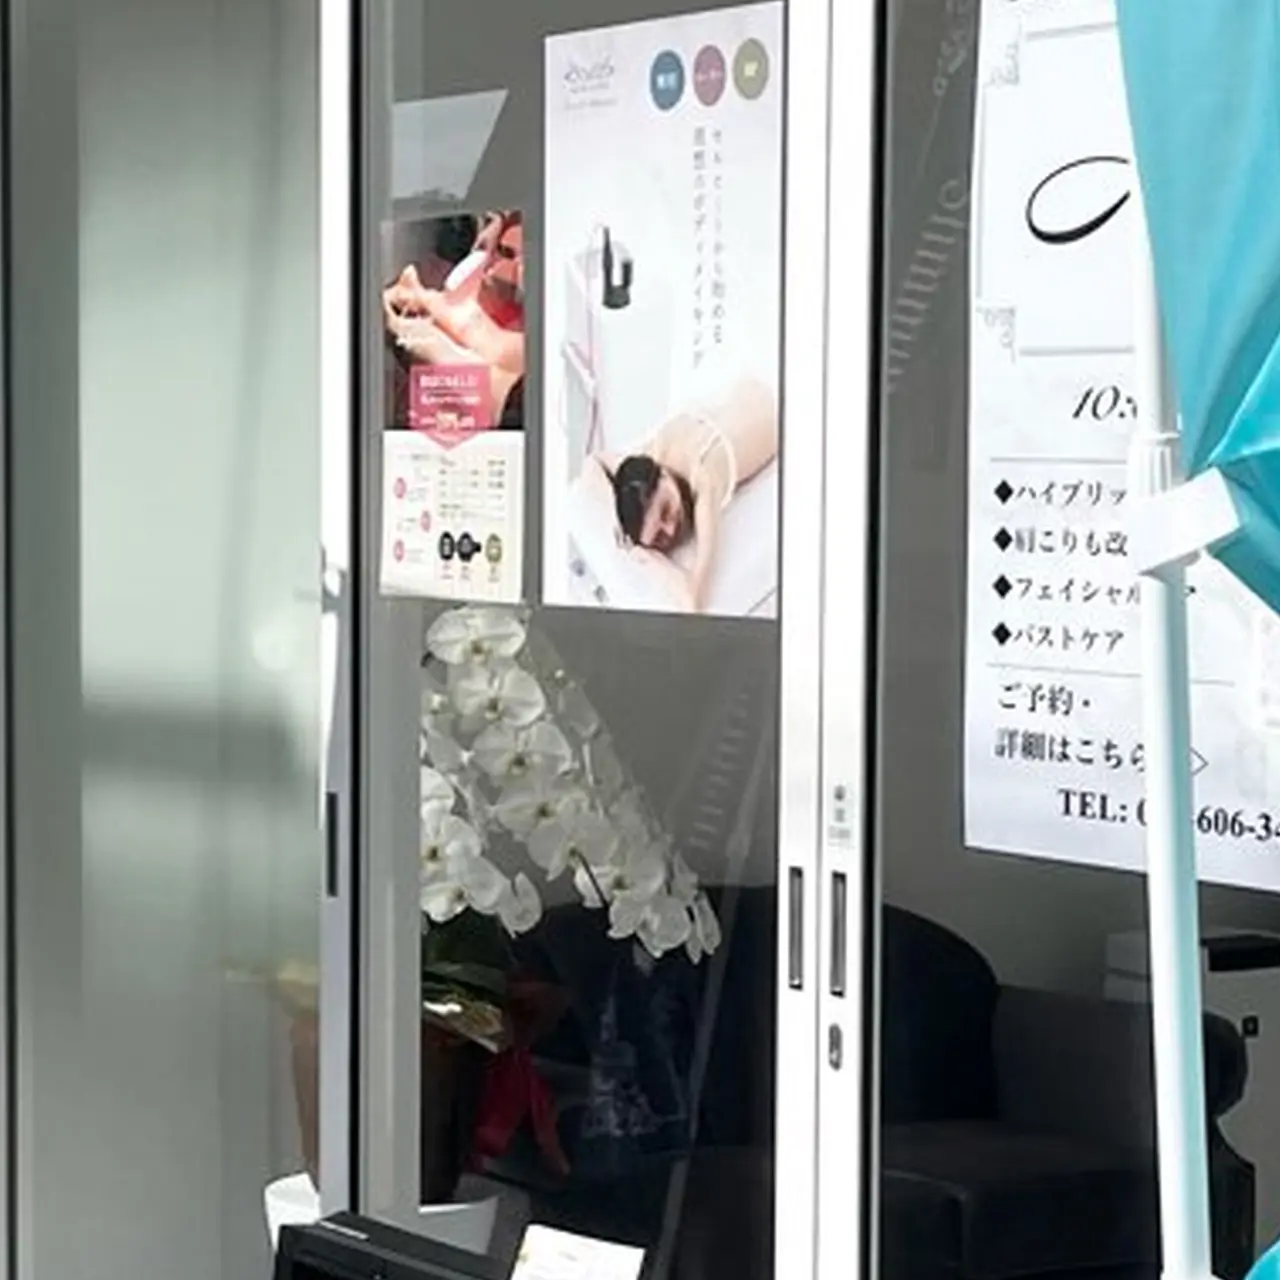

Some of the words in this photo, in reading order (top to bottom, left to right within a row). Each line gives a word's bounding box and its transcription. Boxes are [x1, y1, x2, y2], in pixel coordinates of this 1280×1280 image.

[1014, 622, 1124, 654] バストケア
[997, 681, 1091, 717] ご予約・
[1057, 787, 1128, 823] TEL:
